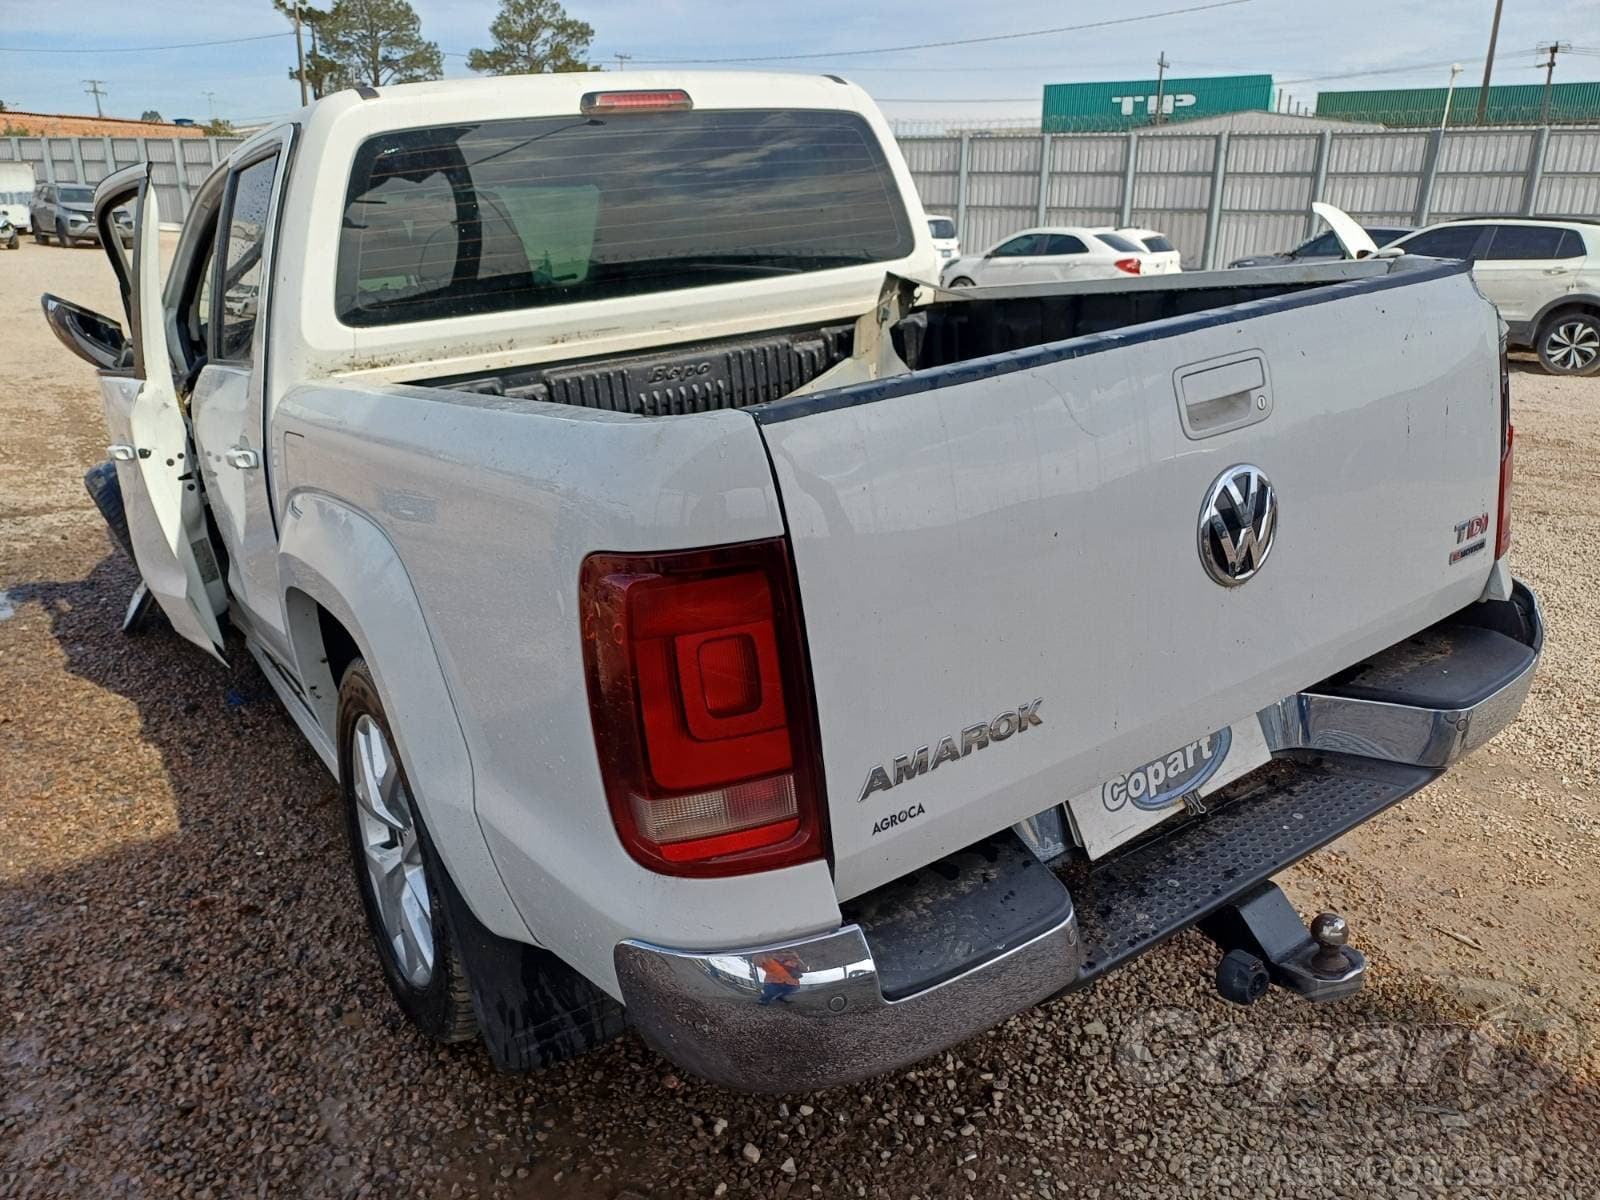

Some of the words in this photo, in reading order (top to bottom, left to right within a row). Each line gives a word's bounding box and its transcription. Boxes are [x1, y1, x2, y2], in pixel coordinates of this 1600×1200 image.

[1453, 515, 1488, 544] TDI
[858, 697, 1043, 803] AMAROK
[1102, 736, 1213, 813] Copart
[872, 803, 925, 836] AGROCA
